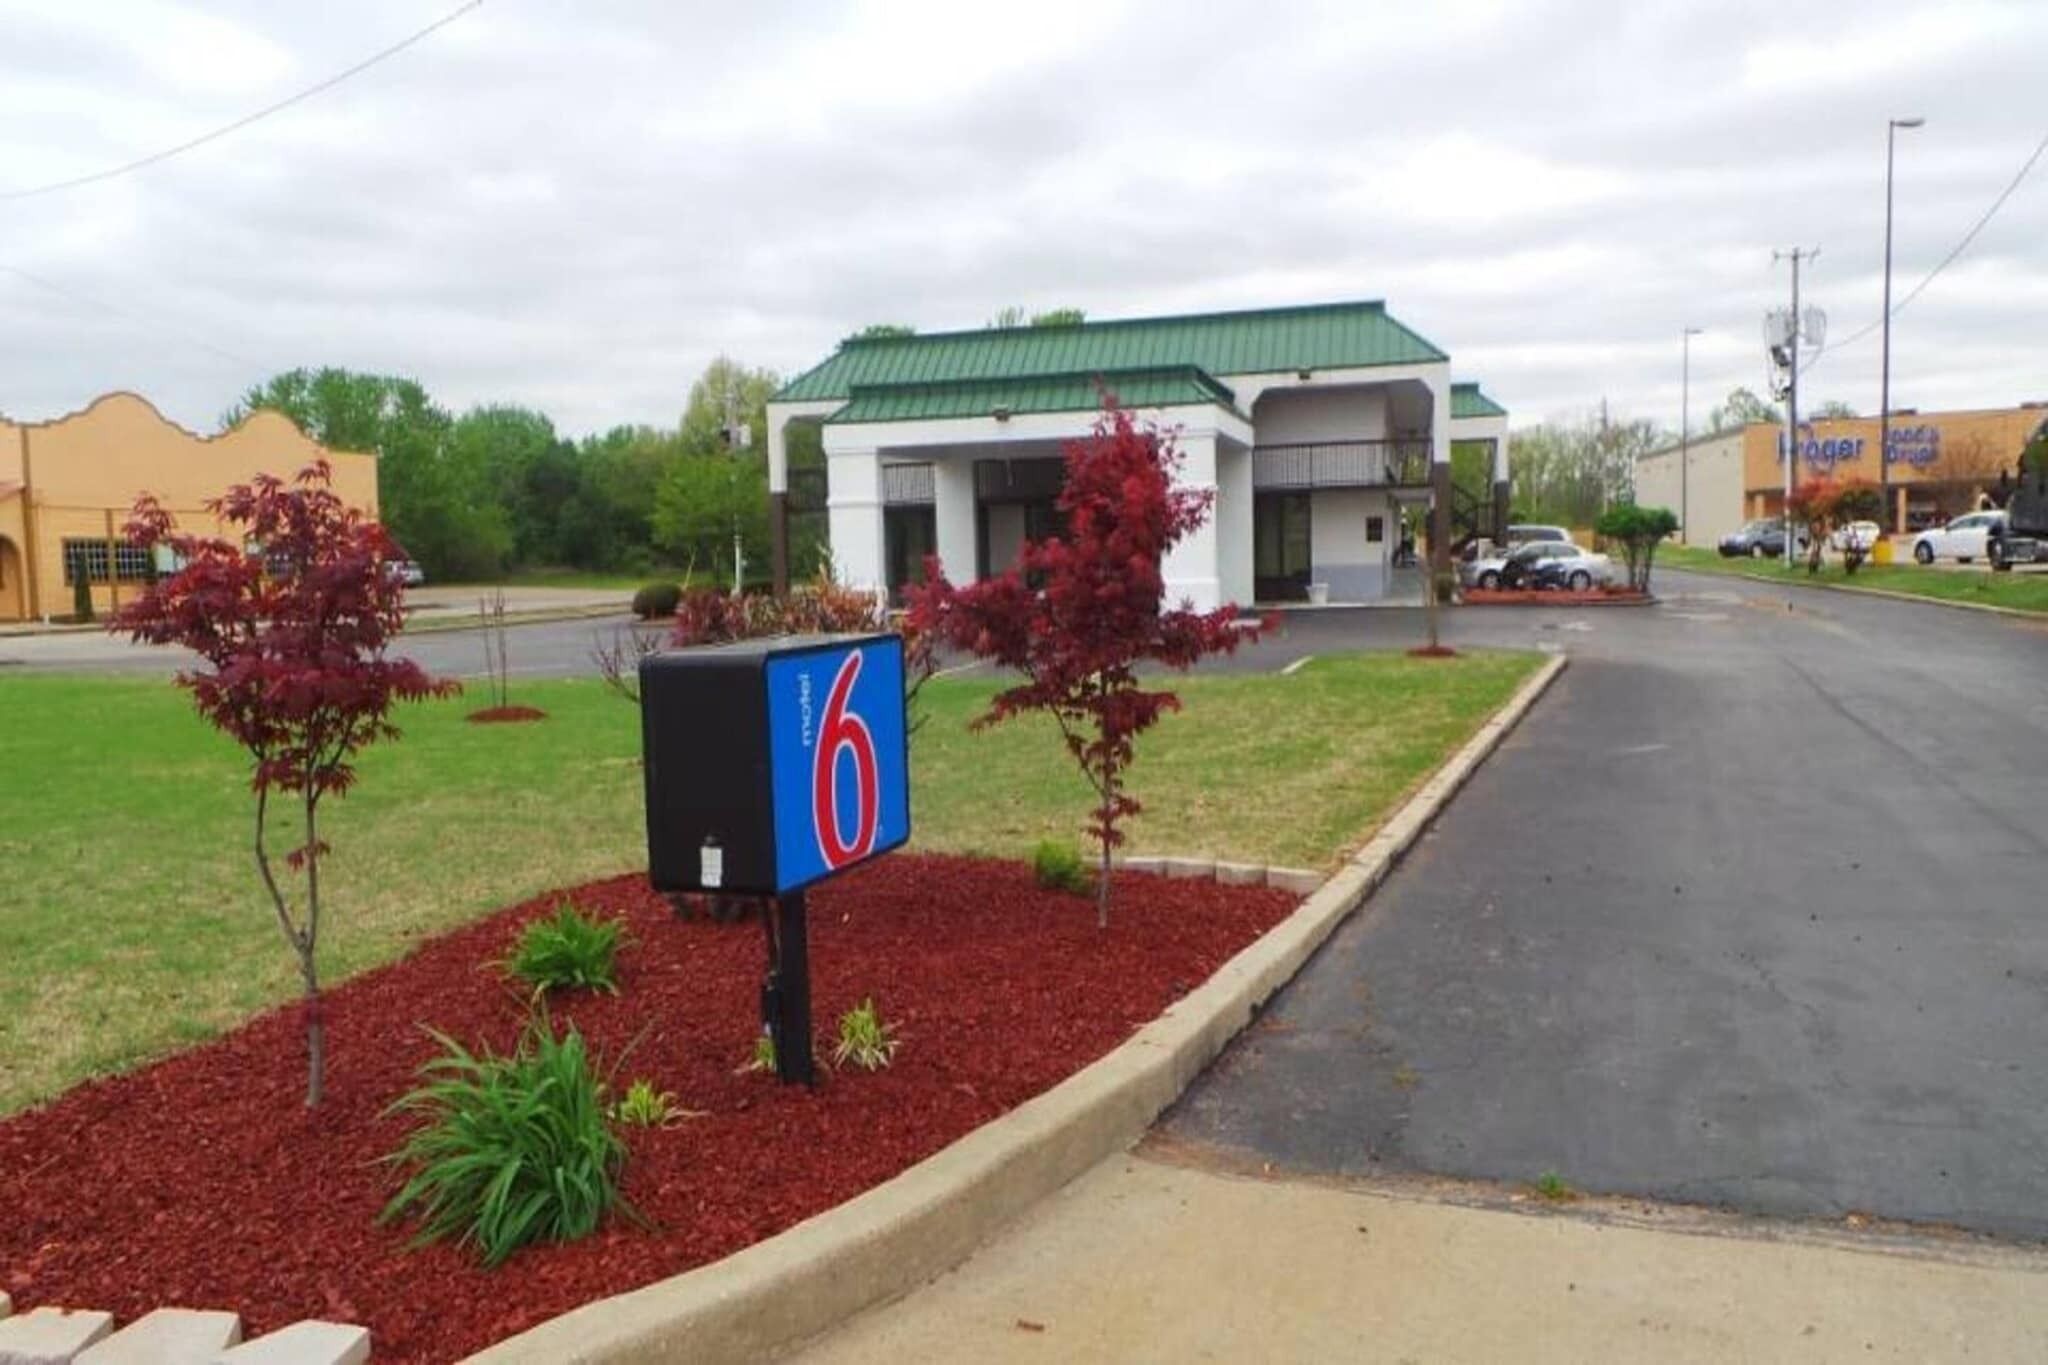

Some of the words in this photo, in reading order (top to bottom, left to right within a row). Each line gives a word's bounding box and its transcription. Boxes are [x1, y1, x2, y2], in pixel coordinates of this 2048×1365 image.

[1885, 426, 1940, 444] oods
[798, 673, 812, 747] motel
[812, 648, 880, 870] 6
